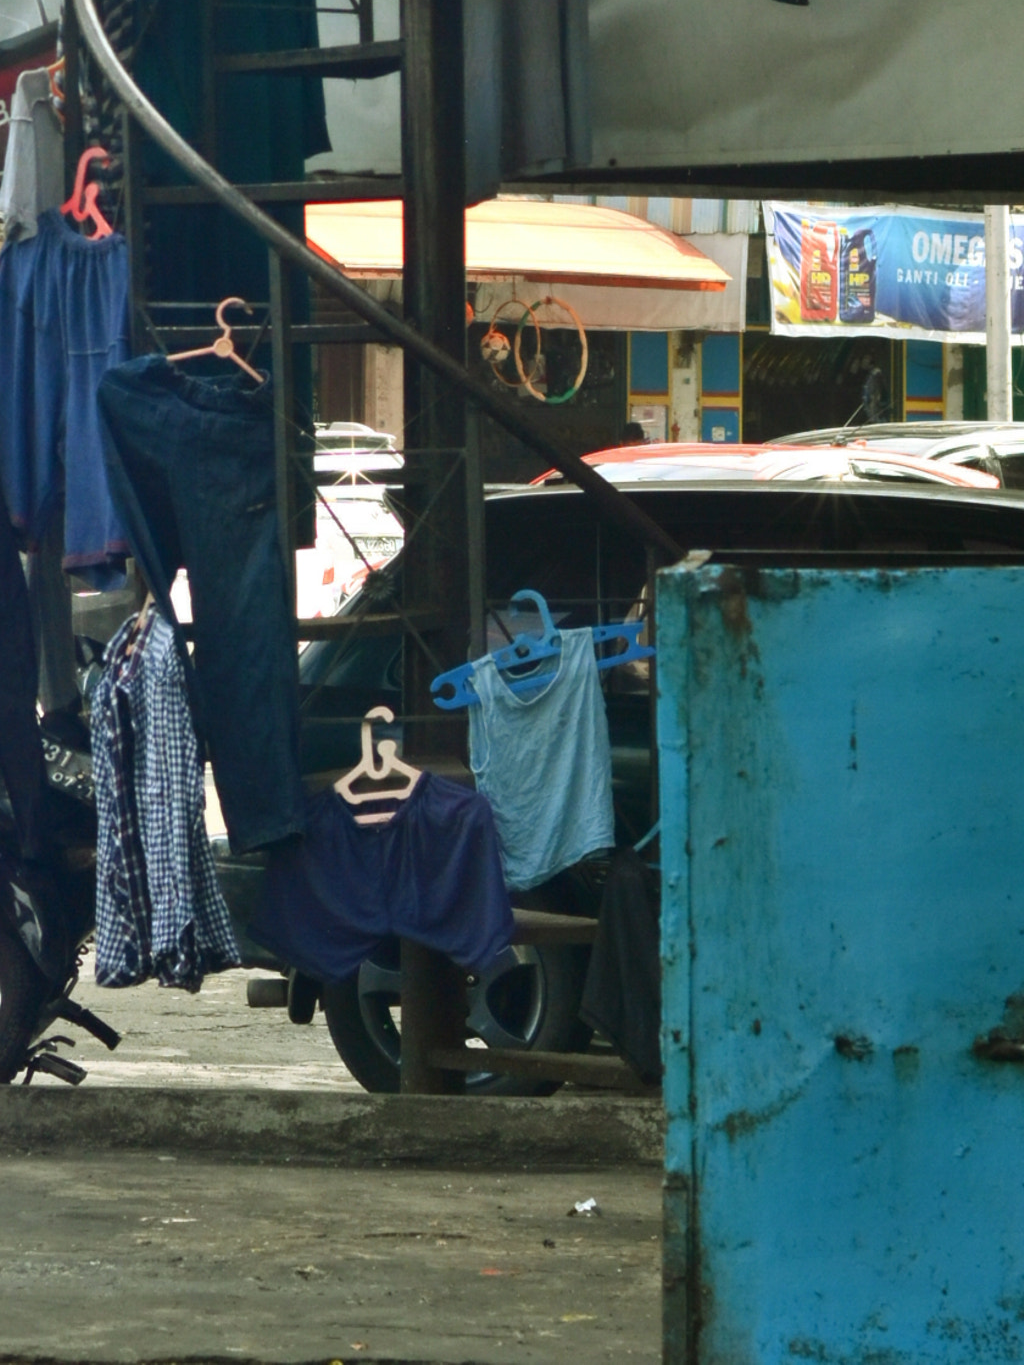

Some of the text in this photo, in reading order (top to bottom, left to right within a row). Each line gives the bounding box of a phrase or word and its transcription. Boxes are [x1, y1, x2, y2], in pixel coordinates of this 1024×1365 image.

[912, 231, 986, 267] OMEG
[896, 268, 938, 286] GANTI
[945, 272, 970, 287] OLI
